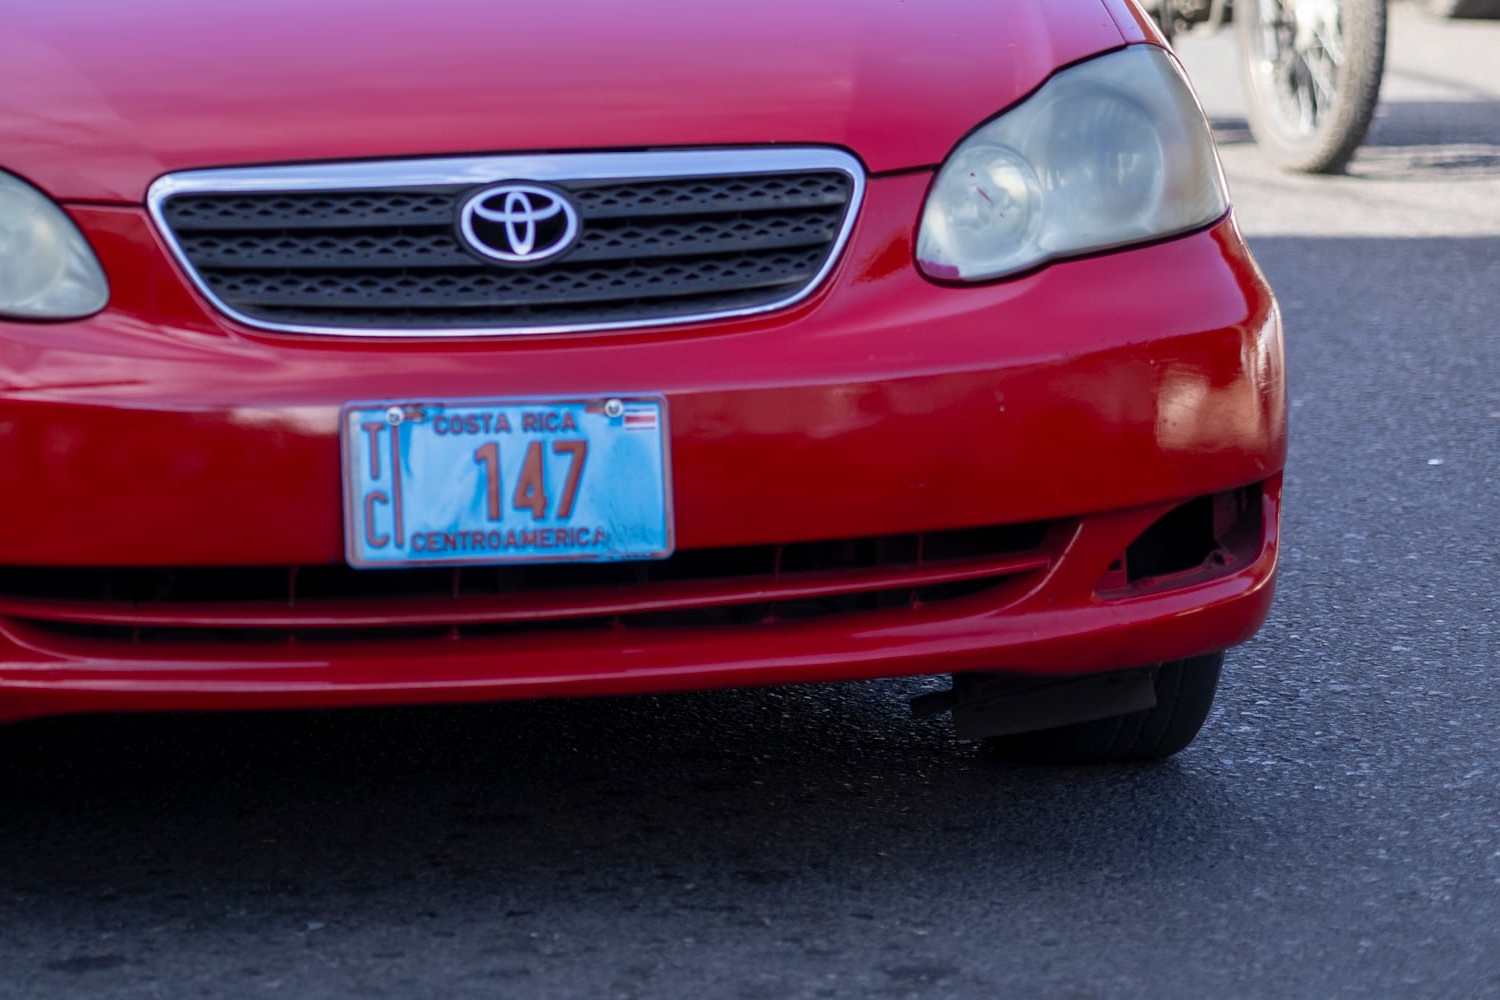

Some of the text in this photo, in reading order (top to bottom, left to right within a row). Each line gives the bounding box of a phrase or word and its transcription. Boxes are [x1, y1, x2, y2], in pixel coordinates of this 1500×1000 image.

[433, 411, 578, 435] COSTA RICA
[474, 439, 589, 522] 147
[411, 527, 608, 552] CENTROAMERICA
